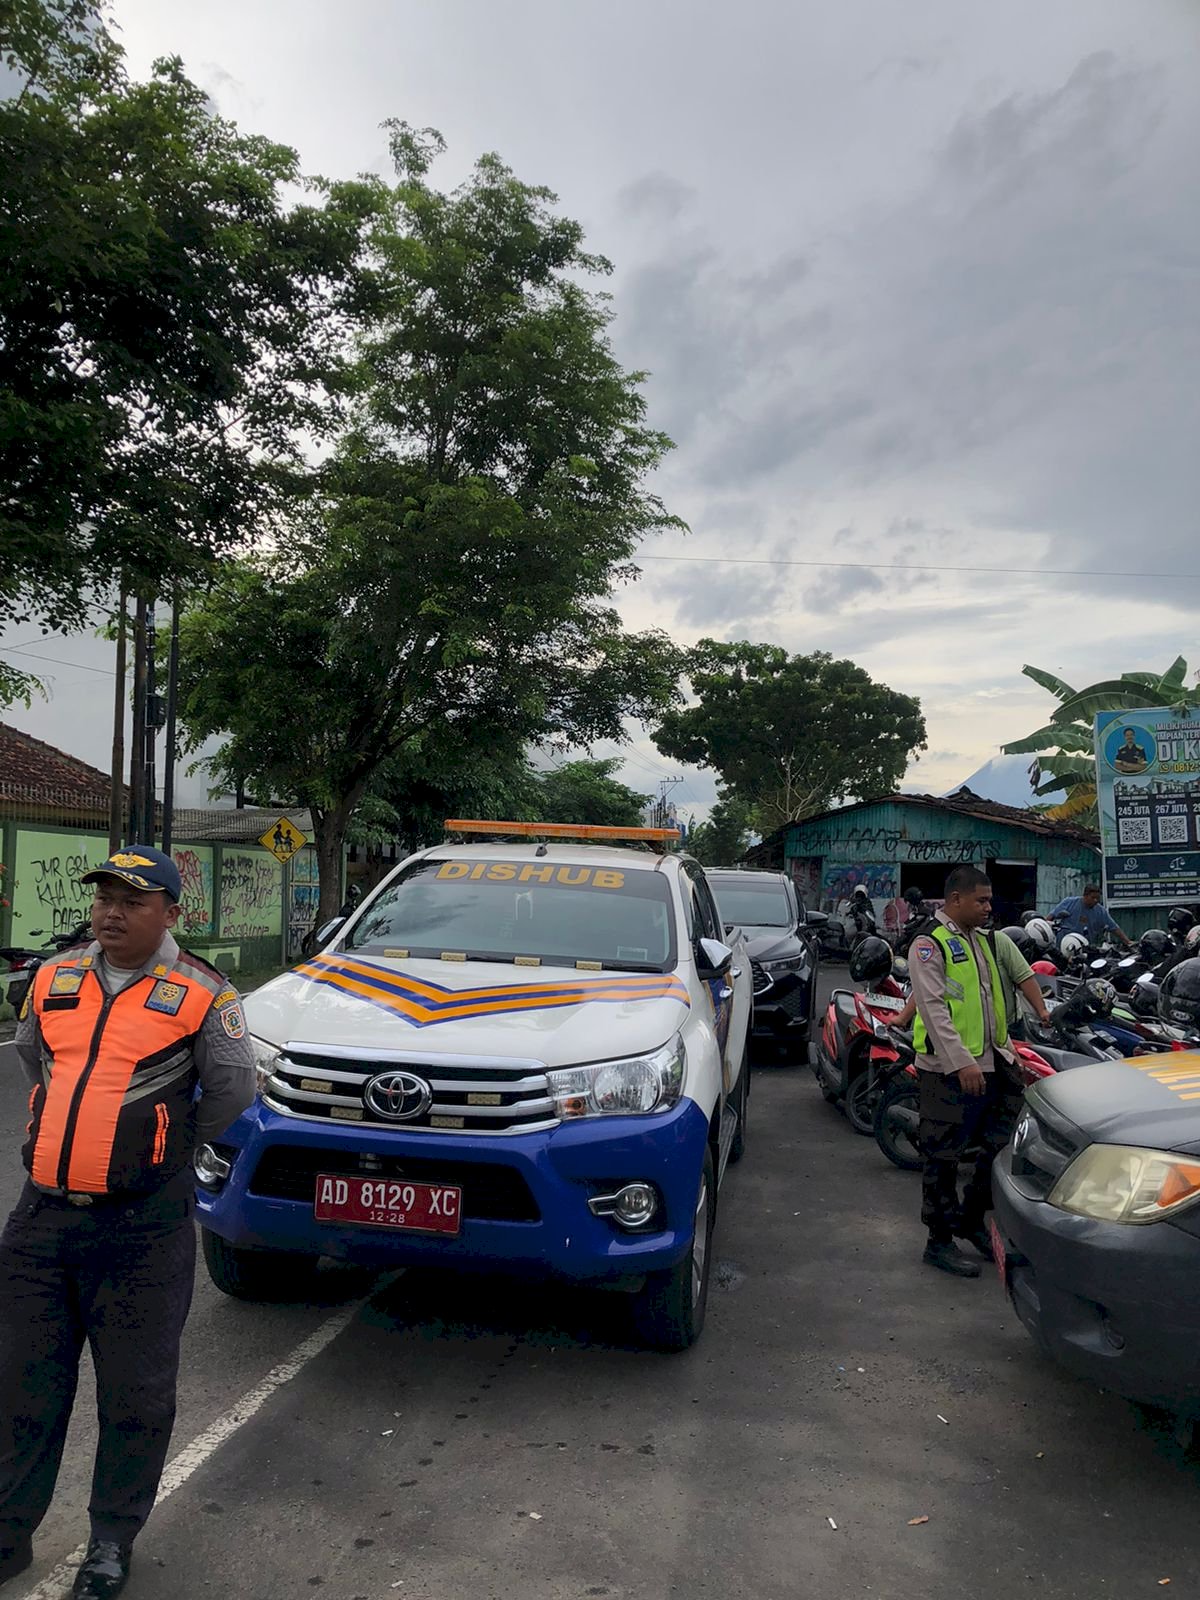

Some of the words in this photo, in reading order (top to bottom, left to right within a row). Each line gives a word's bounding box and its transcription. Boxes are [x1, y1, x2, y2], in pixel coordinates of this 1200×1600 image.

[1158, 741, 1178, 760] DI
[1185, 740, 1200, 760] K
[1118, 806, 1132, 815] 245
[1134, 806, 1150, 815] JUTA
[1155, 805, 1169, 814] 267
[1171, 804, 1188, 813] JUTA
[436, 863, 625, 889] DISHUB
[321, 1179, 348, 1205] AD
[360, 1182, 415, 1212] 8129
[428, 1188, 456, 1216] XC
